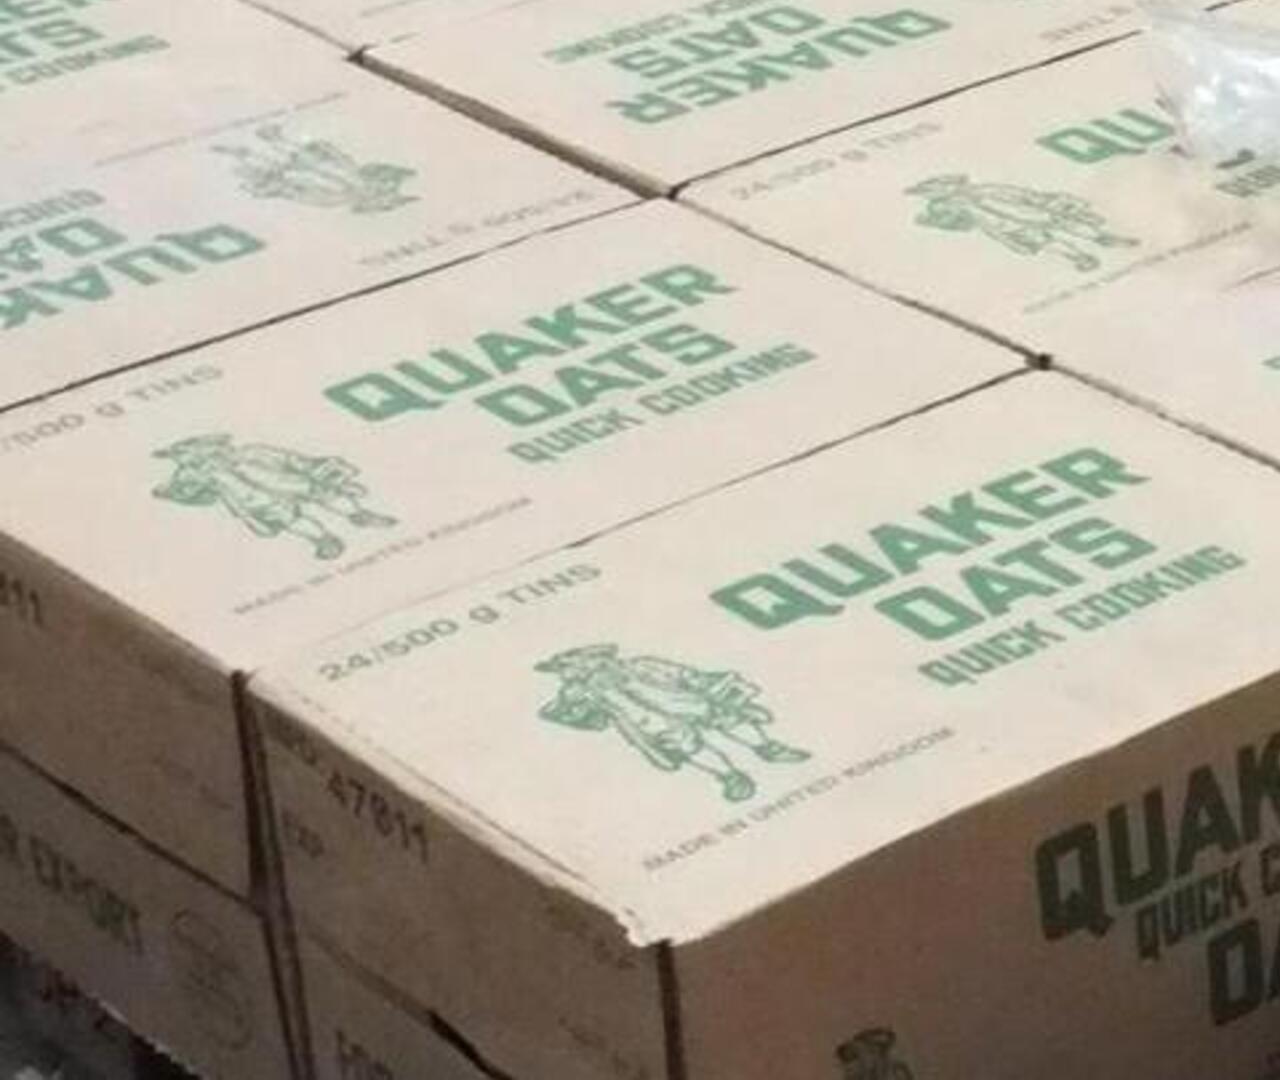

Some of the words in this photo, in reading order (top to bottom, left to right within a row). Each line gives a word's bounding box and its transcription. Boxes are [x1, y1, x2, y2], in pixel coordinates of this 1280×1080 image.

[607, 3, 830, 81] OATS
[607, 6, 954, 125] QUAKER
[322, 262, 740, 422] QUAKER
[474, 323, 738, 428] OATS
[506, 408, 648, 466] QUICK
[637, 341, 819, 417] COOKING
[708, 446, 1153, 631] QUAKER
[873, 516, 1159, 641] OATS
[317, 616, 460, 684] 24/500
[469, 604, 501, 625] g
[503, 561, 604, 607] TINS
[917, 618, 1067, 688] QUICK
[1055, 544, 1248, 632] COOKING
[1135, 851, 1249, 963] QUICK
